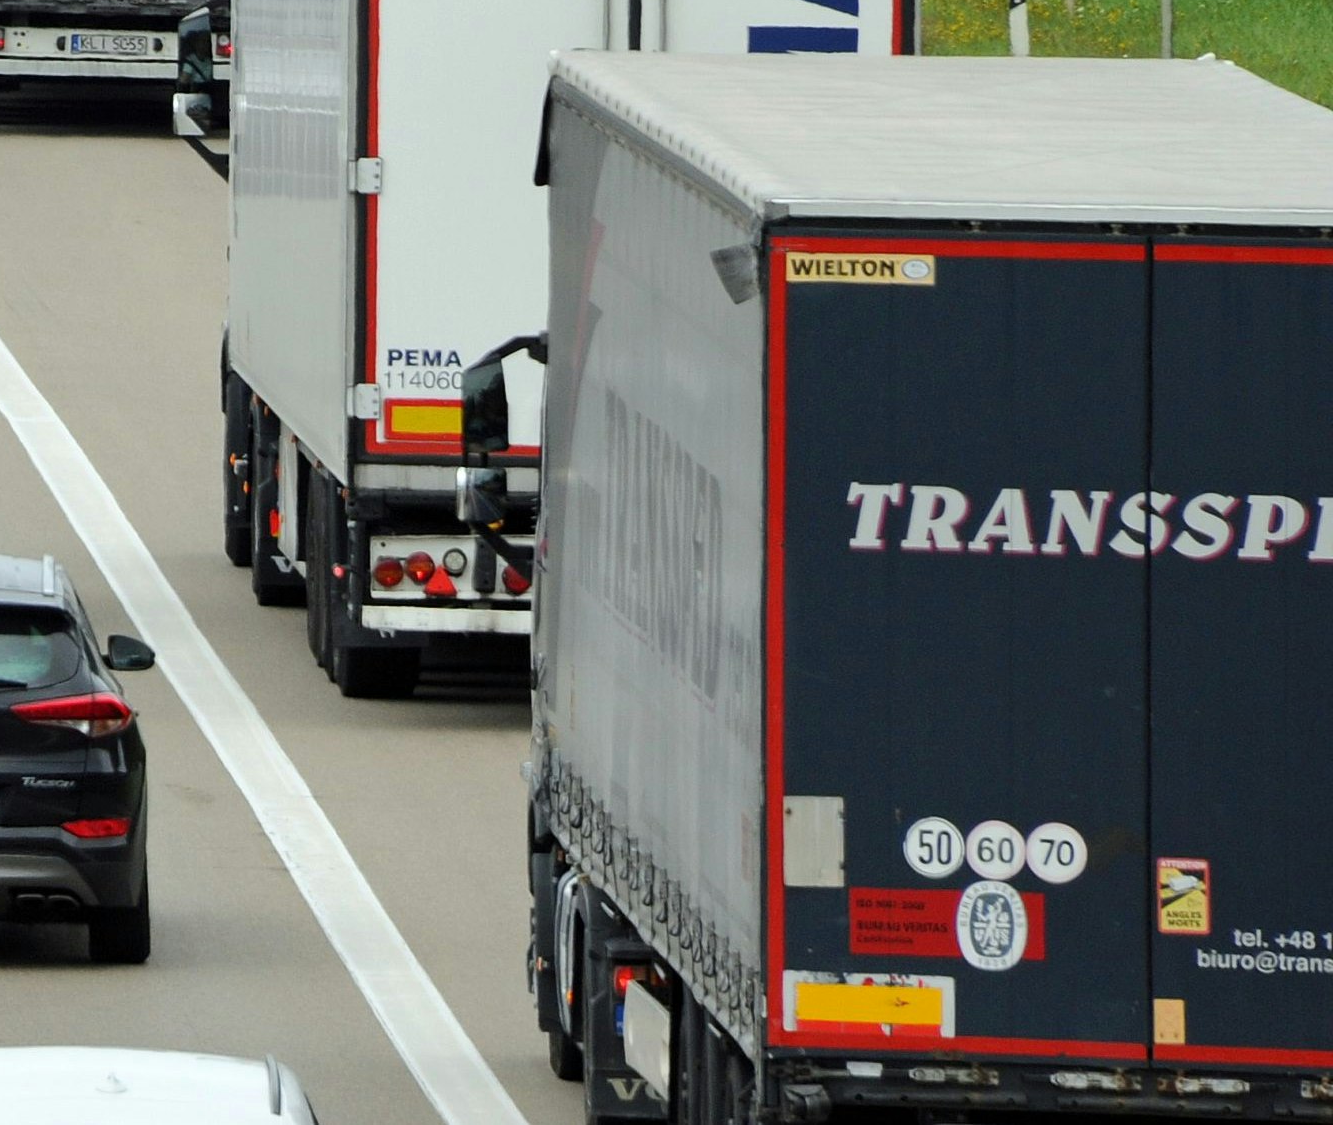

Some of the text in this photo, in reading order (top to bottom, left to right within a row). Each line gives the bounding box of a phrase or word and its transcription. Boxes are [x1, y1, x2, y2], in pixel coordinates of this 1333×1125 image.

[790, 258, 895, 278] WIELTON
[387, 349, 462, 368] PEMA
[919, 829, 952, 866] 50
[977, 836, 1015, 864] 60
[1040, 839, 1075, 866] 70
[1166, 910, 1202, 920] ANGLES
[1167, 919, 1201, 928] MORTS
[904, 922, 949, 934] VERITAS
[1234, 929, 1269, 948] tel.
[1274, 931, 1316, 950] +48
